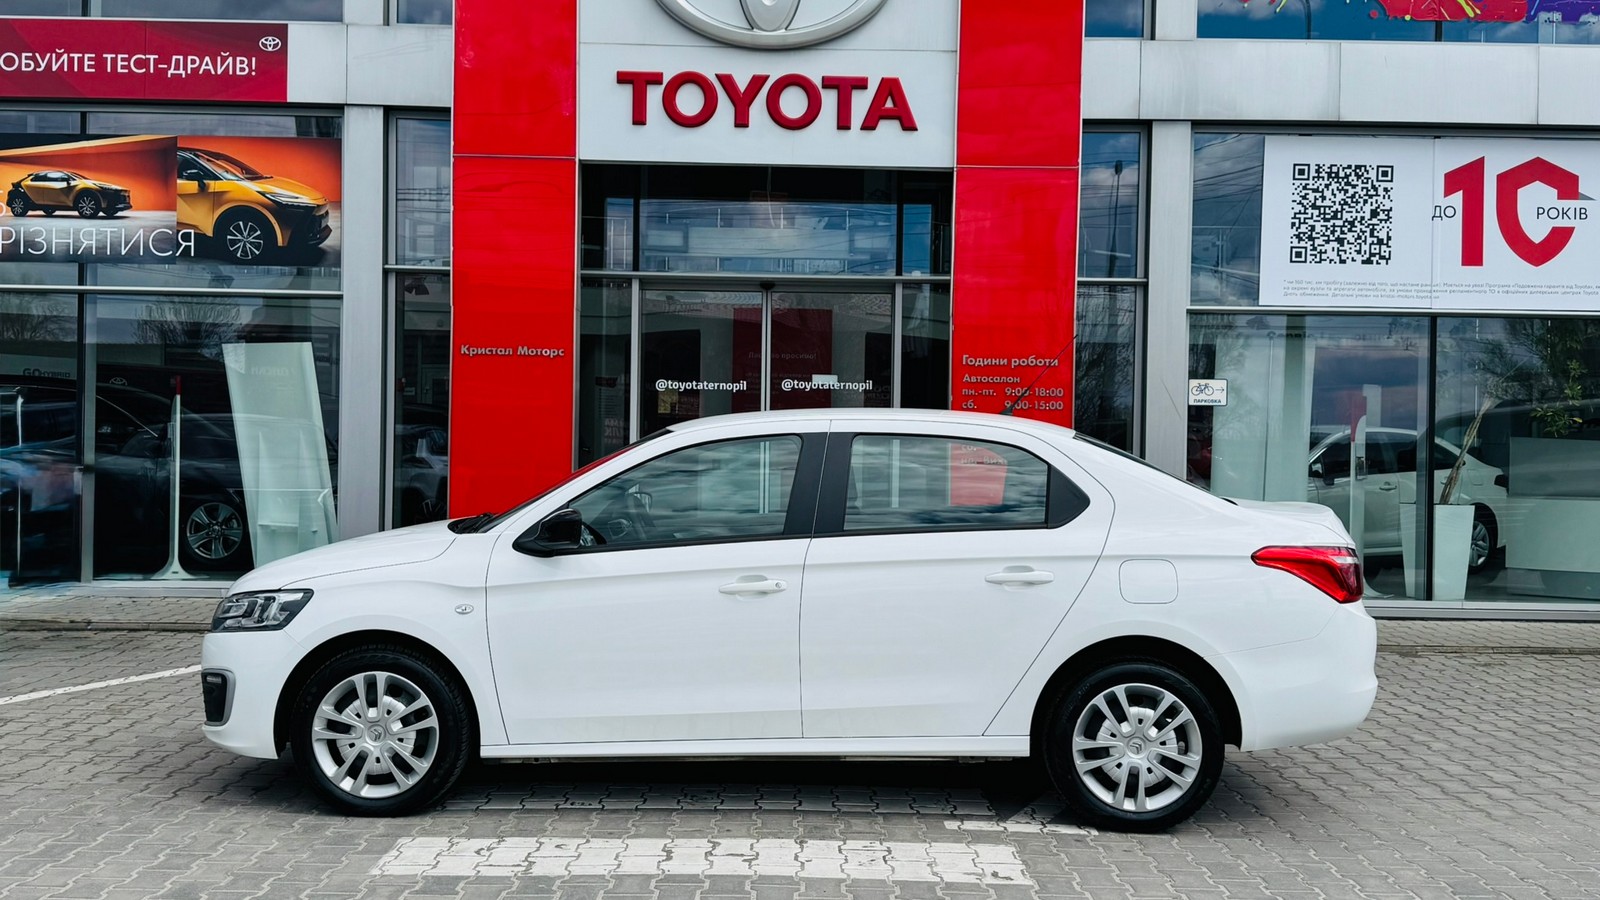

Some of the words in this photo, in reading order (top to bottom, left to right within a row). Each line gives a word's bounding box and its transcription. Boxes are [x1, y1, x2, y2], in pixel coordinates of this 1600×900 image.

[0, 48, 96, 73] ОБУЙТЕ
[102, 52, 257, 78] ТЕСТ-ДРАЙВ!
[616, 70, 918, 131] TOYOTA
[1431, 205, 1457, 222] ДО
[1535, 206, 1589, 221] РОКІВ
[0, 226, 195, 257] РІЗНЯТИСЯ
[460, 344, 513, 356] Кристал
[516, 345, 565, 358] Моторс
[962, 354, 1008, 367] Години
[1011, 355, 1059, 368] роботи
[962, 373, 1020, 383] Автосалон
[655, 379, 747, 393] @toyotaternopil
[781, 379, 873, 393] @toyotaternopil
[962, 399, 977, 409] сб.
